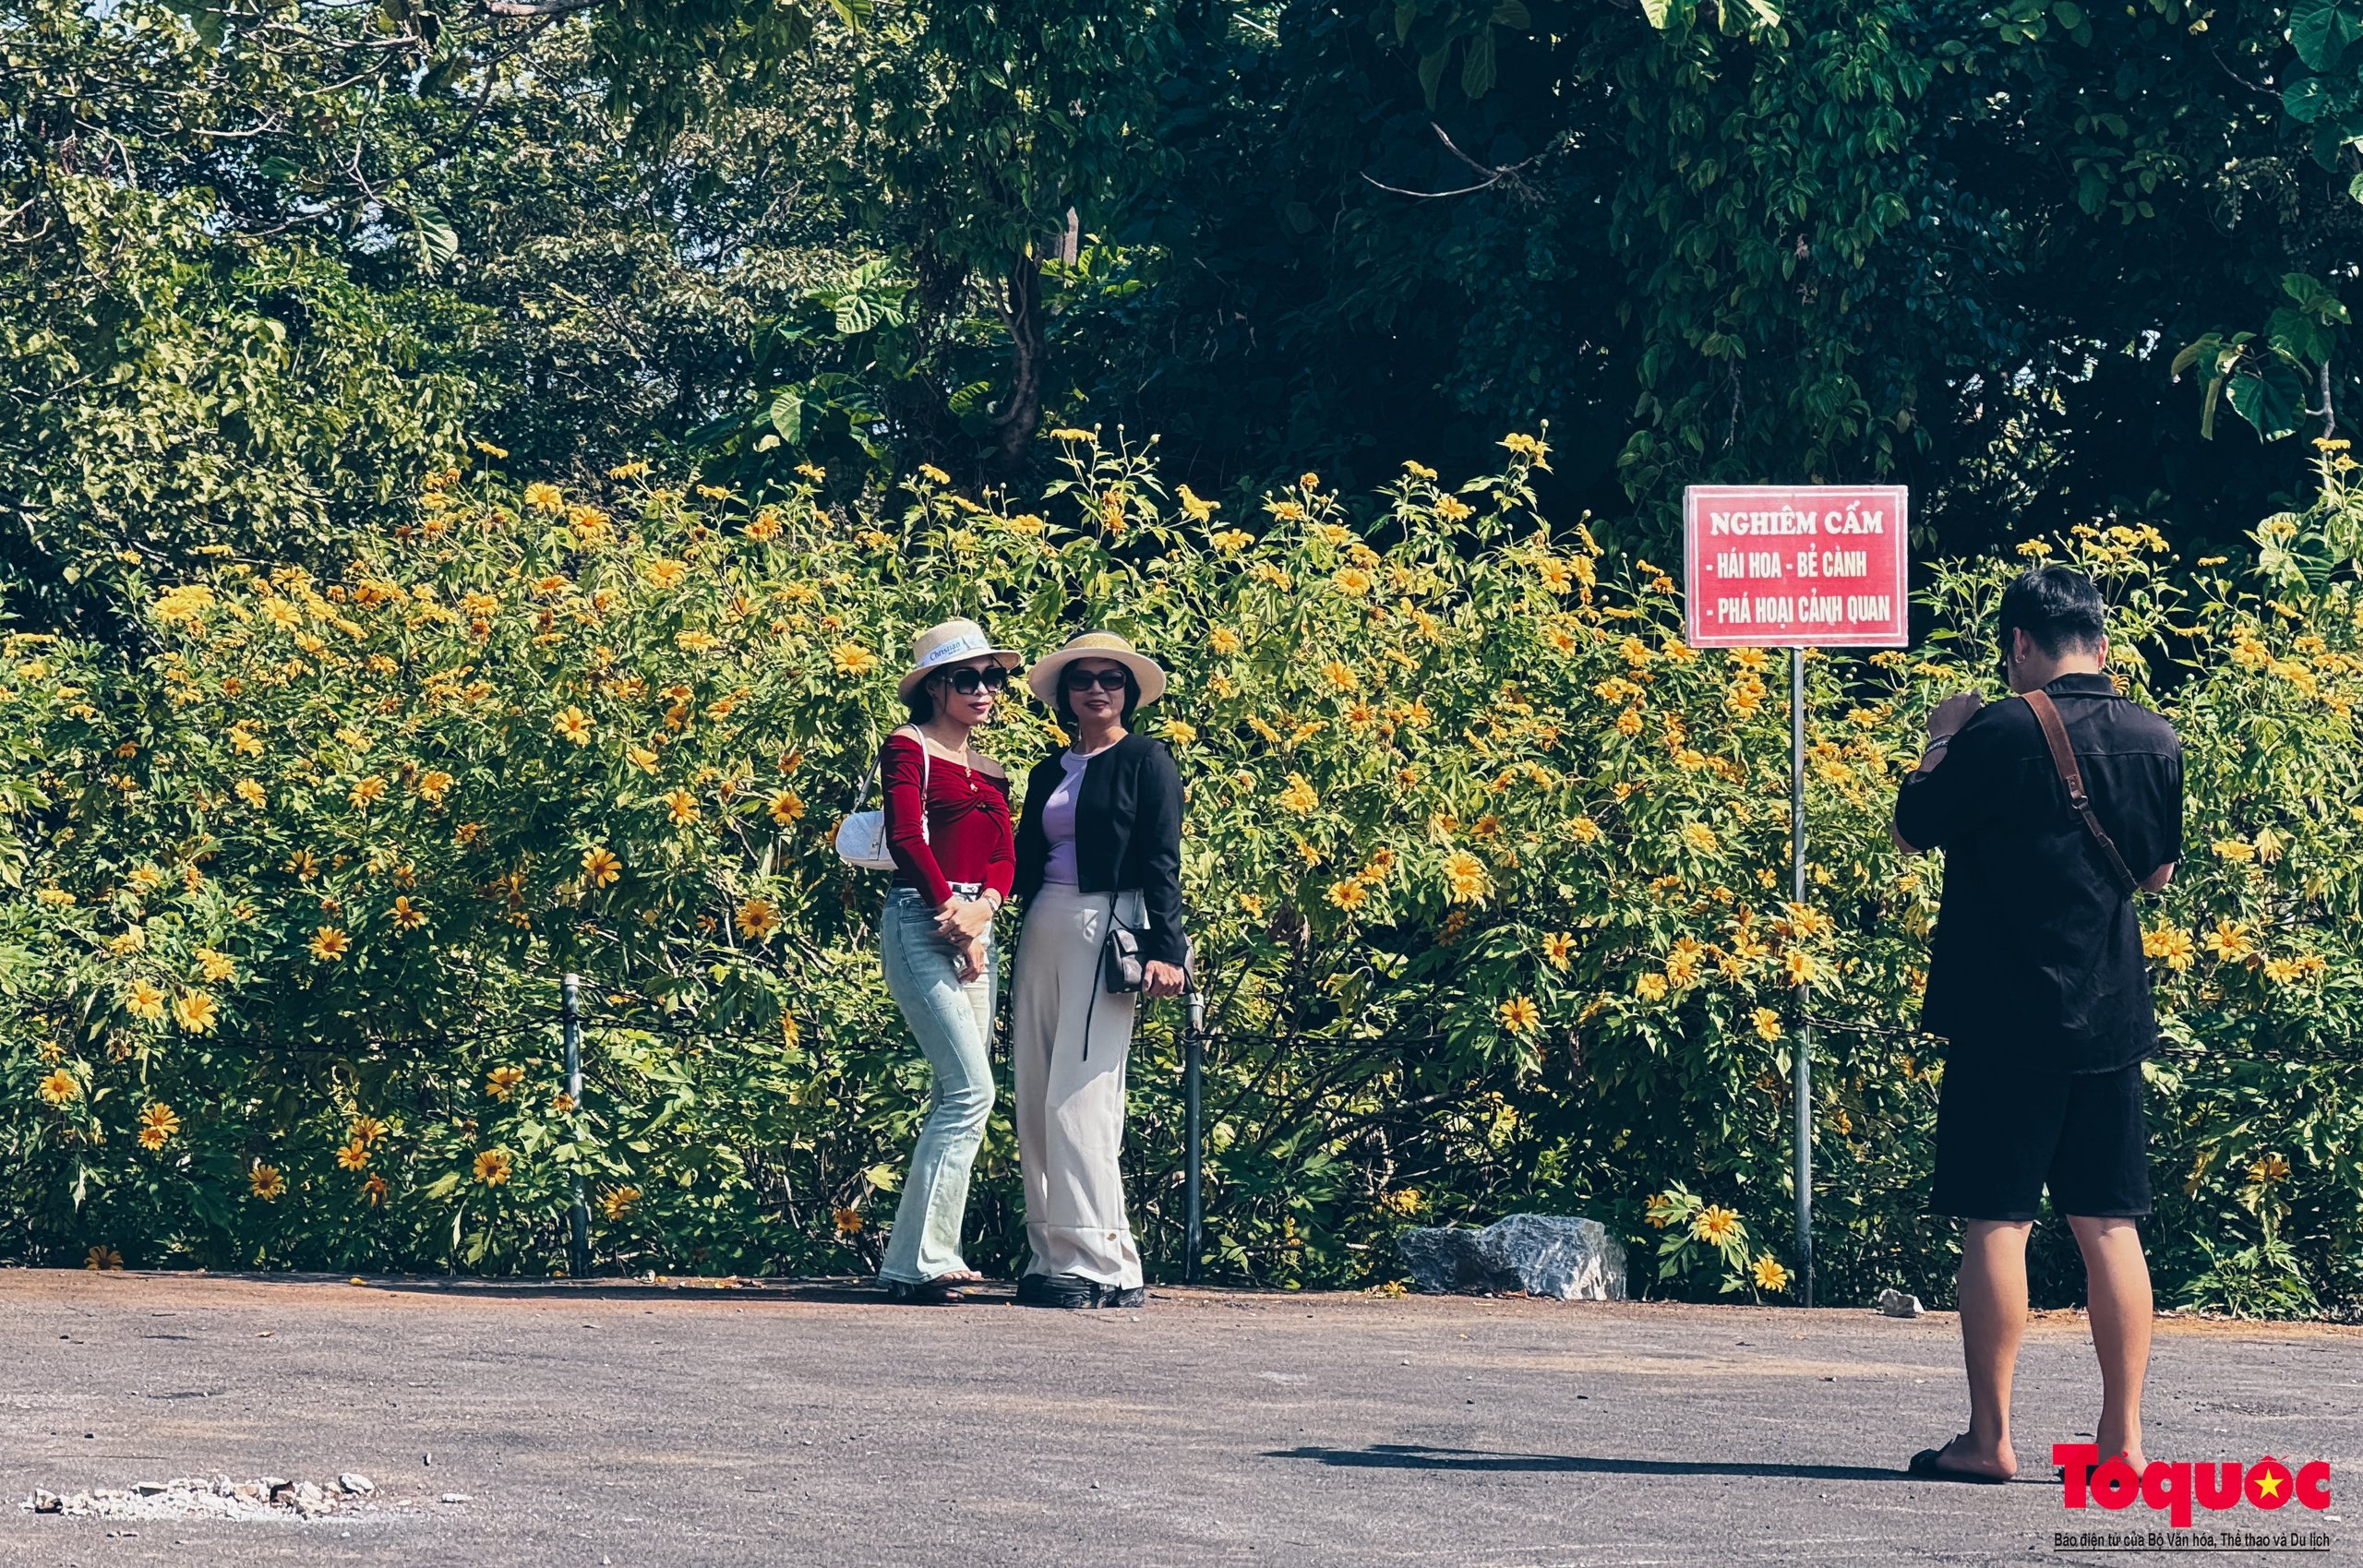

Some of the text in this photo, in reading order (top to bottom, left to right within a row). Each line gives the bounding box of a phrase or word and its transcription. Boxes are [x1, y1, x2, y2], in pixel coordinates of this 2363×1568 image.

[1709, 500, 1884, 535] NGHIÊM CẤM
[1717, 547, 1745, 579] HÁI
[1748, 551, 1782, 579] HOA
[1797, 543, 1818, 578] BẺ
[1718, 592, 1752, 624] PHÁ
[1756, 596, 1794, 628] HOẠI
[1798, 588, 1843, 623] CẢNH
[1847, 595, 1890, 625] QUAN
